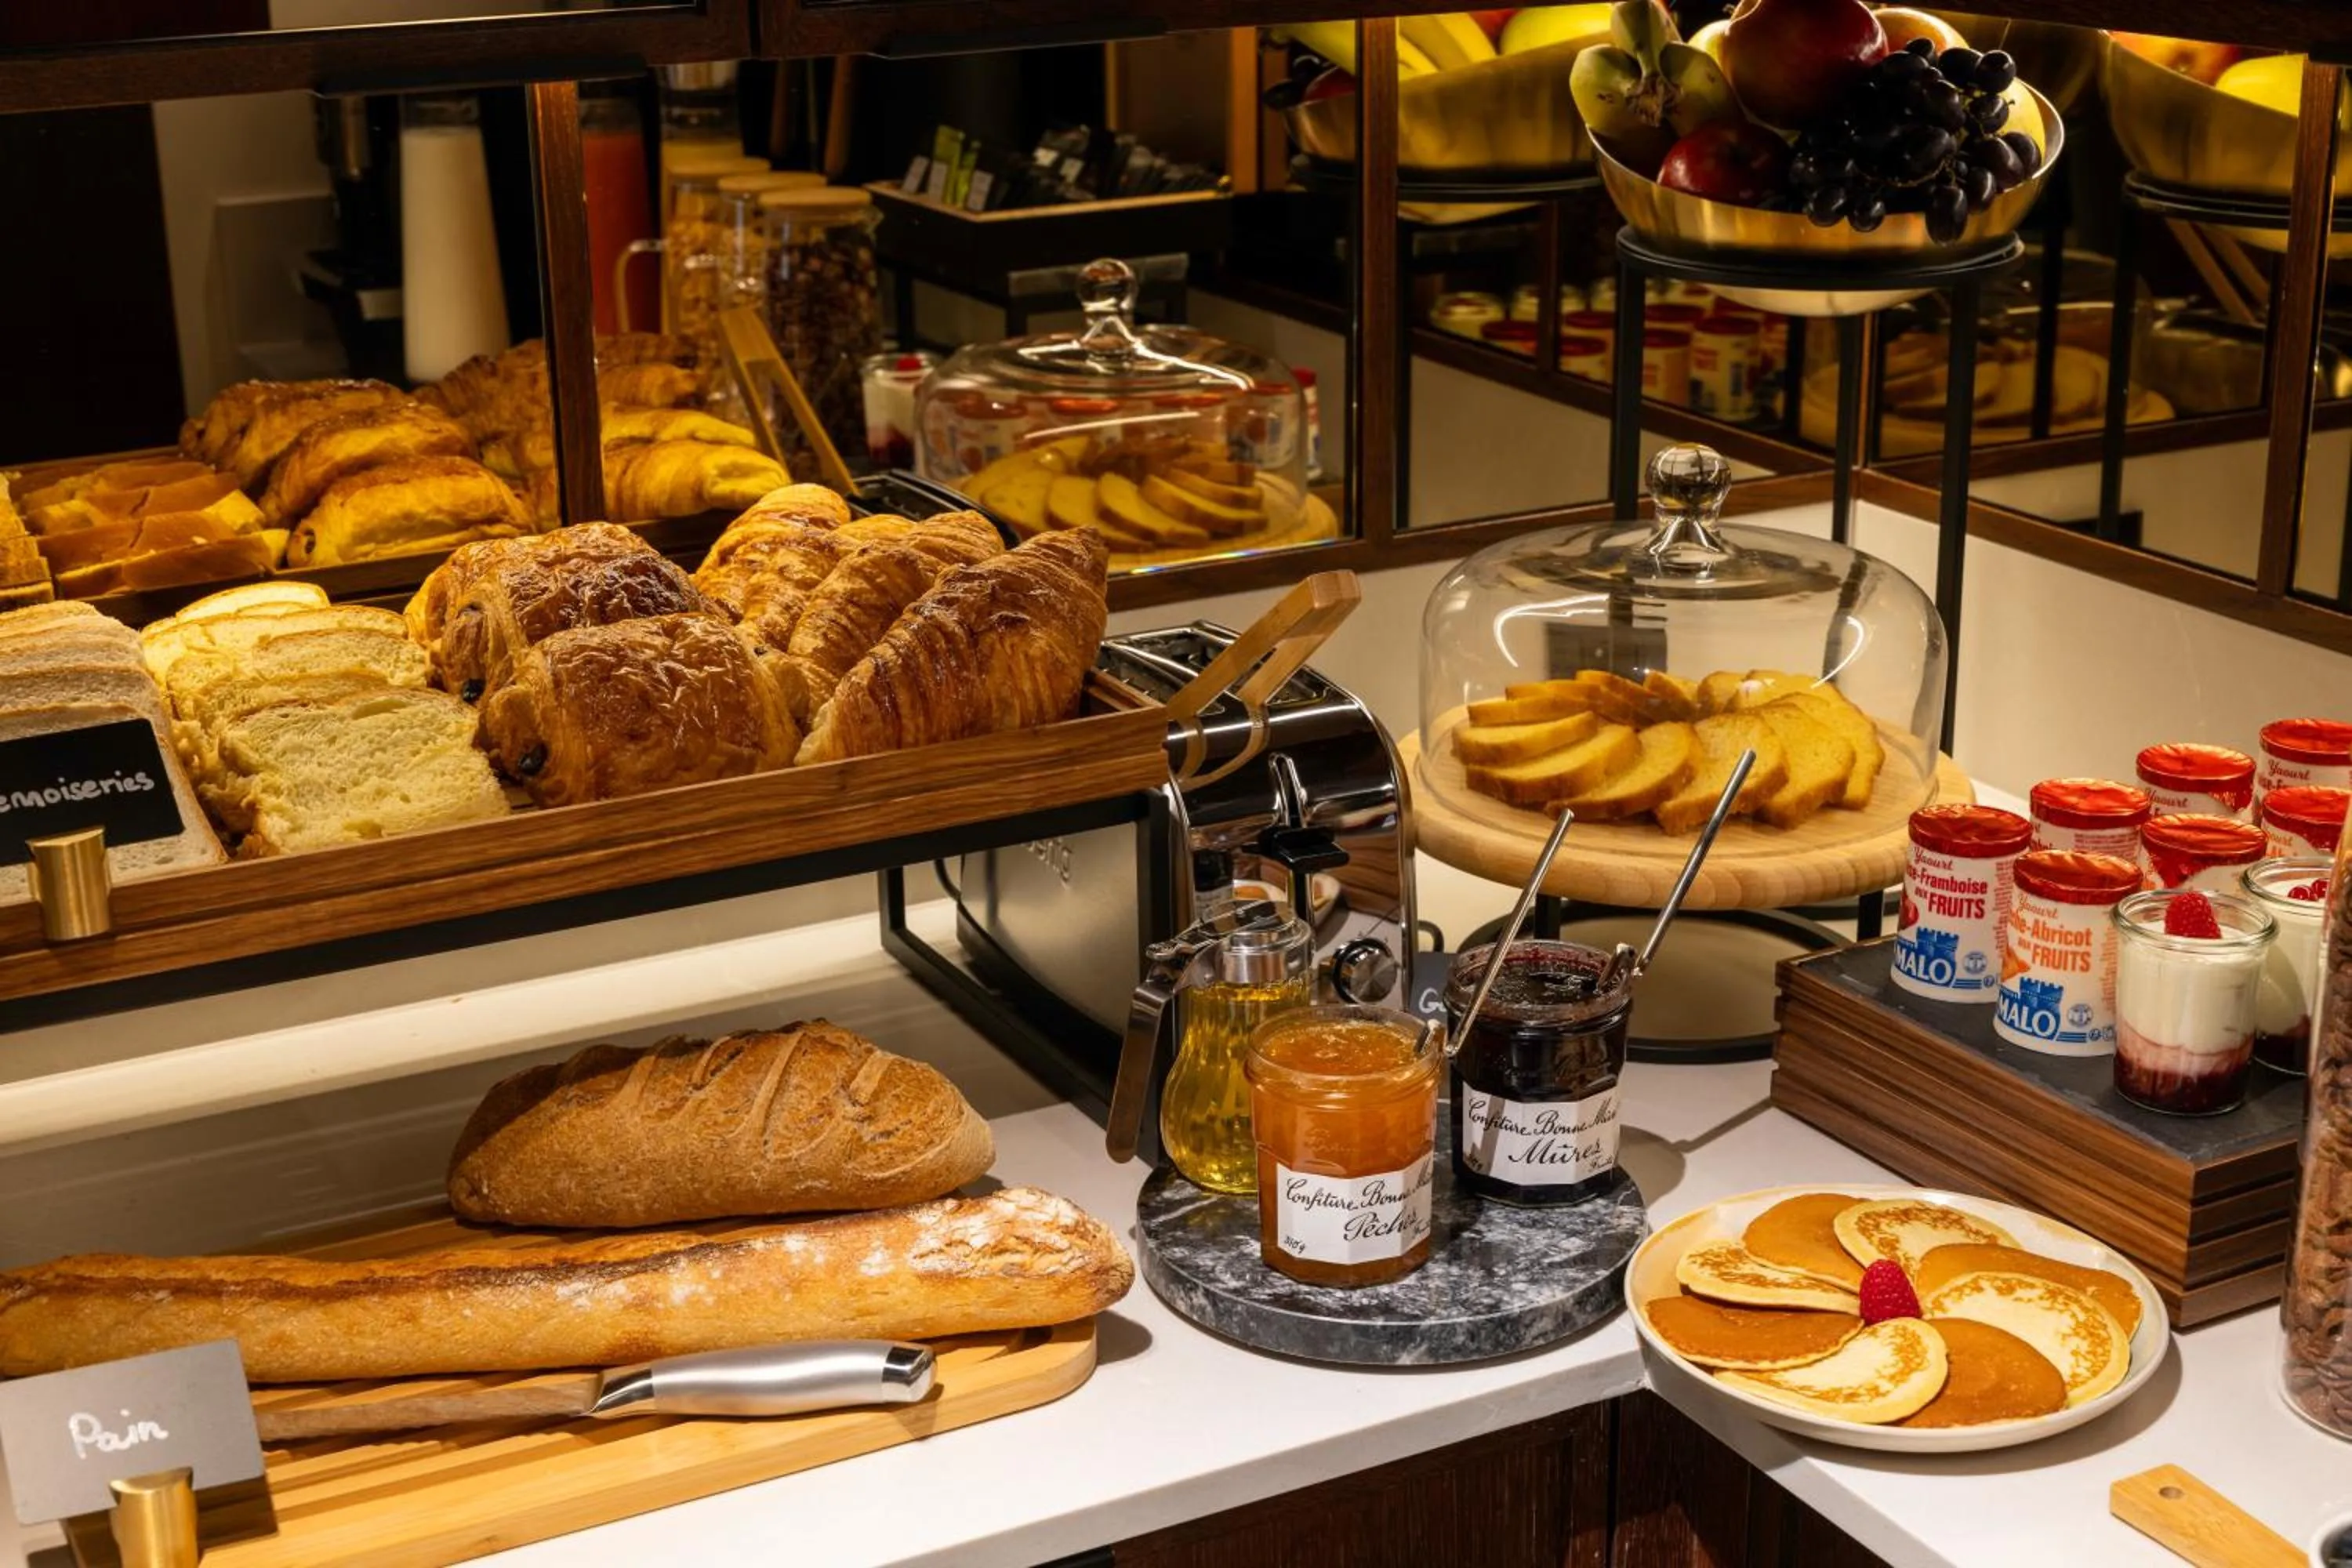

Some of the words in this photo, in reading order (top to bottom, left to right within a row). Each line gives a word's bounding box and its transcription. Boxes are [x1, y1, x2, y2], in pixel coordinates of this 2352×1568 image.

[1928, 891, 1985, 920] FRUITS
[1895, 943, 1952, 985] MALO
[2031, 944, 2092, 973] FRUITS
[1999, 993, 2056, 1037] MALO
[1468, 1098, 1532, 1137] Confiture
[1534, 1109, 1588, 1136] Bonne
[1286, 1178, 1359, 1212] Confiture
[68, 1410, 169, 1459] Pain
